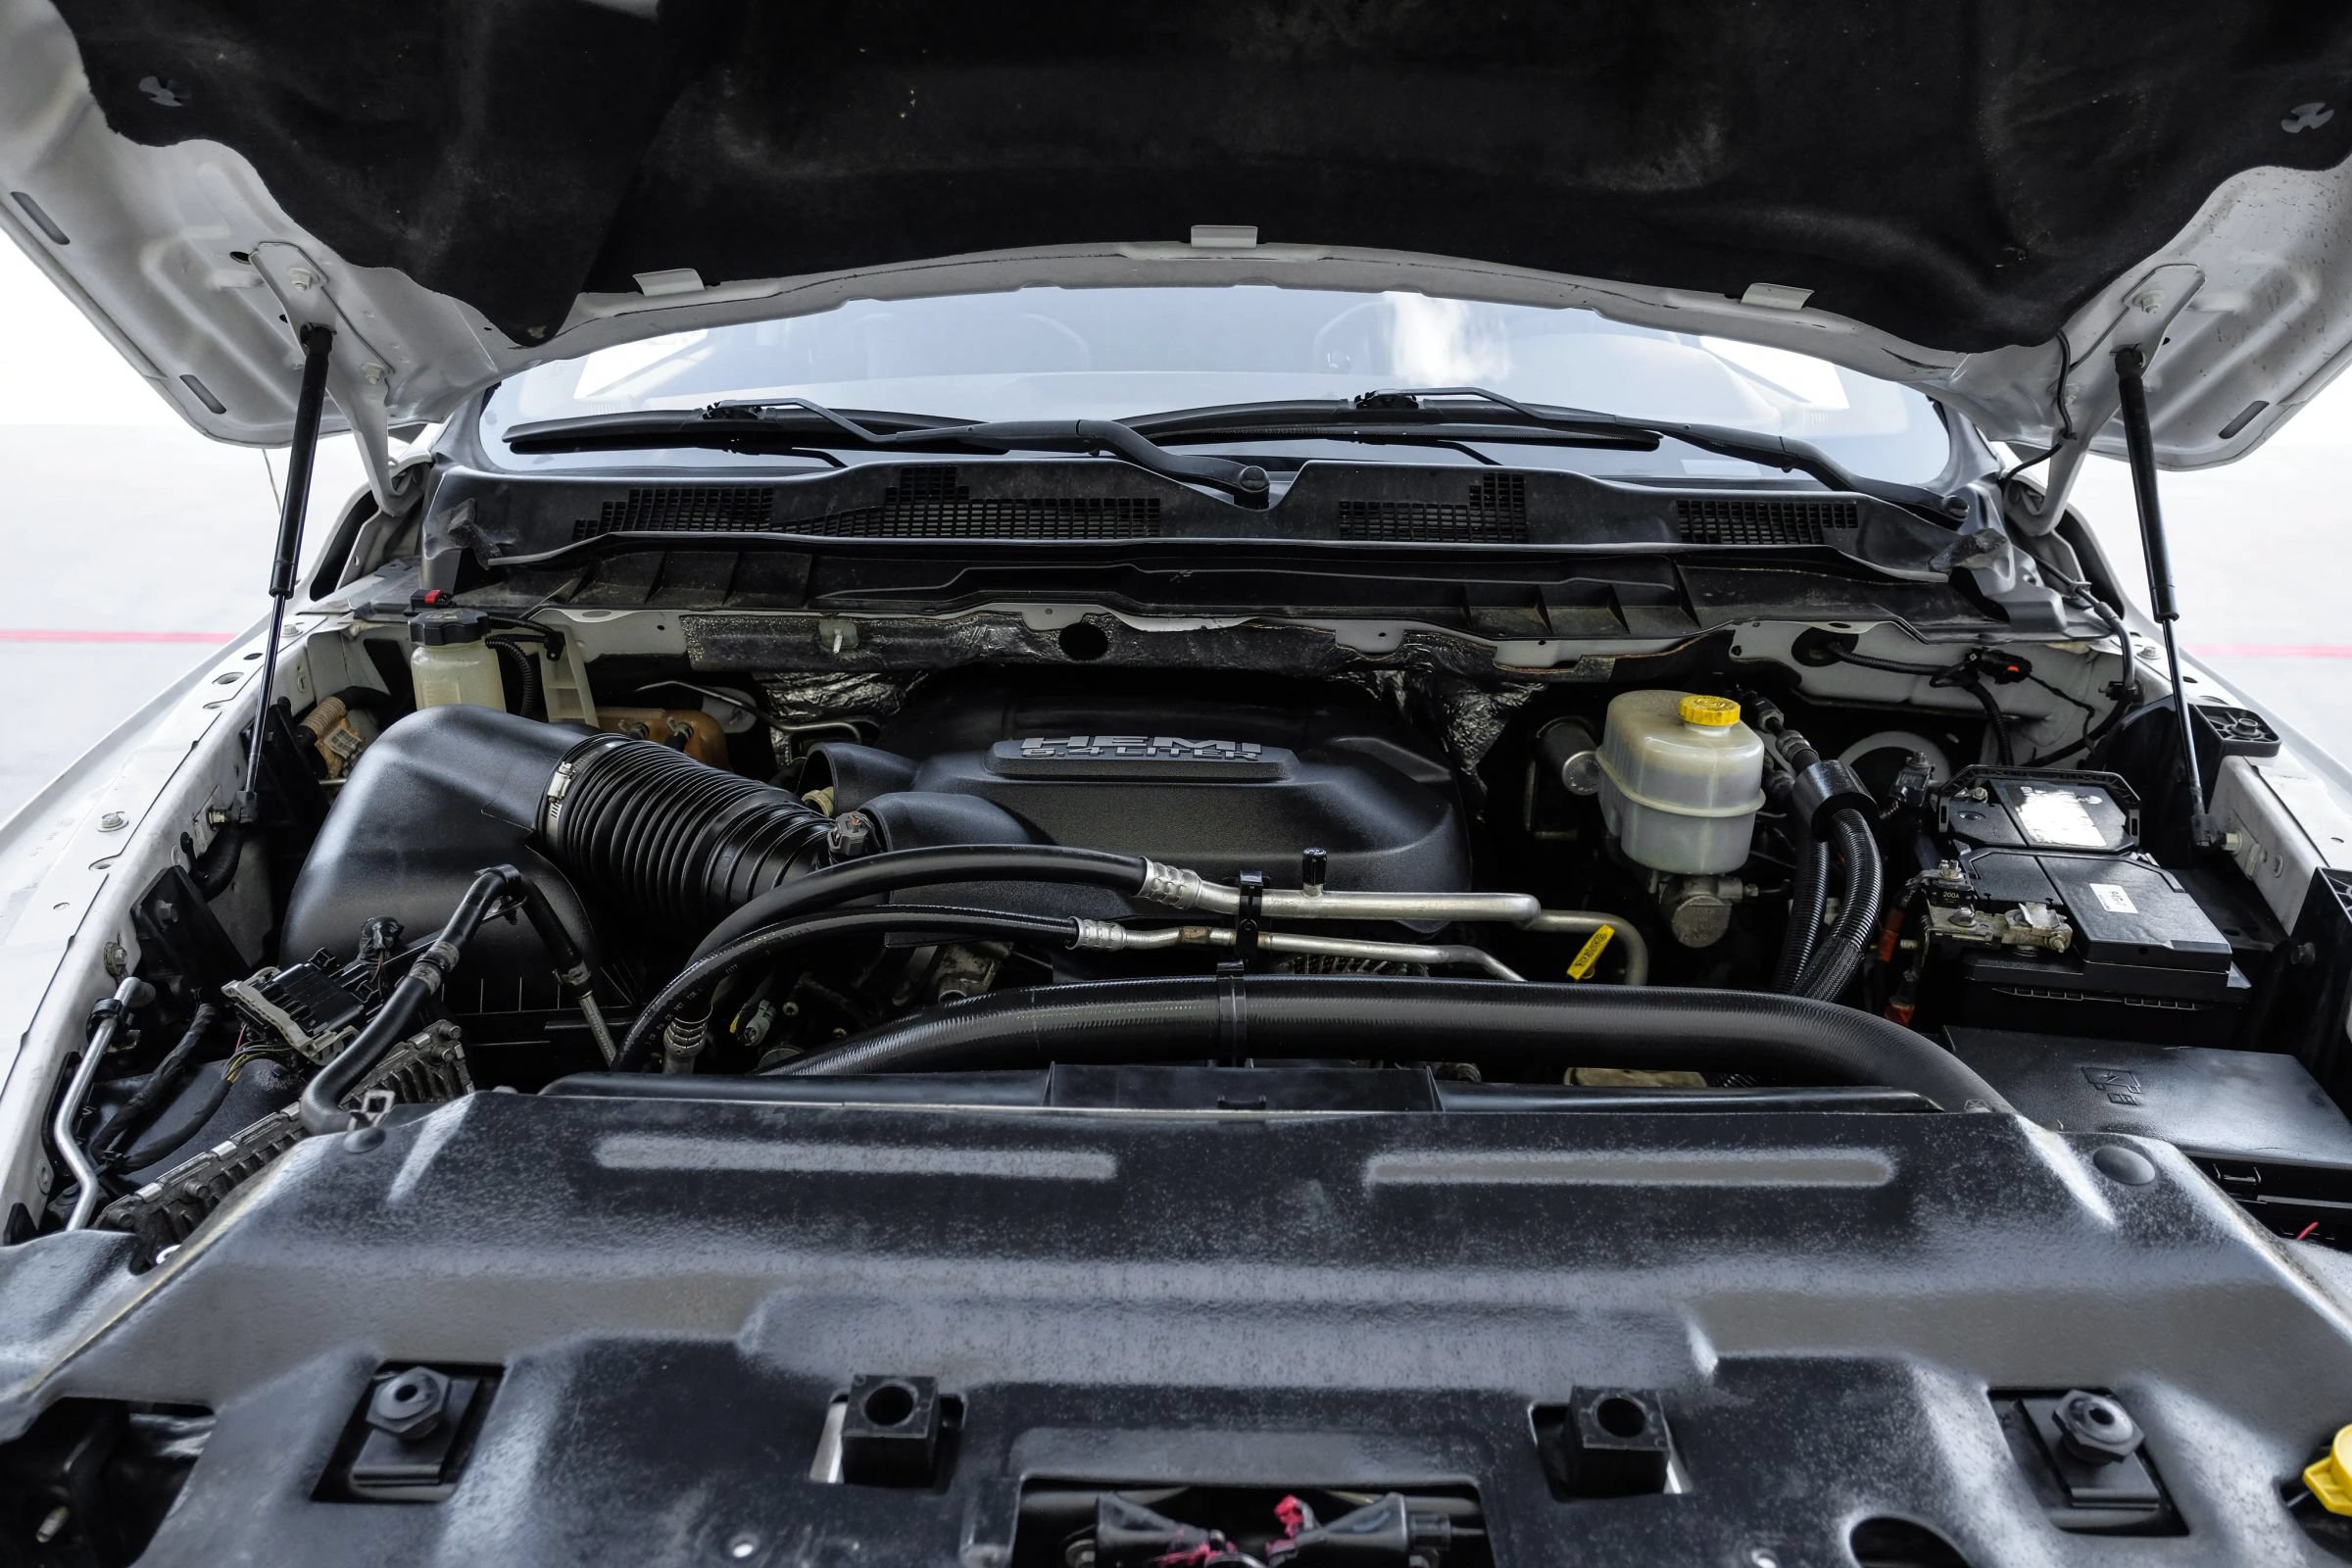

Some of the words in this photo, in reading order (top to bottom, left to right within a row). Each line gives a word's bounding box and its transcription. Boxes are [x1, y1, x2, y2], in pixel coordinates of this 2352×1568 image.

[1020, 735, 1262, 754] HEMI
[1021, 746, 1104, 758] 6.4
[1115, 746, 1259, 761] LITER
